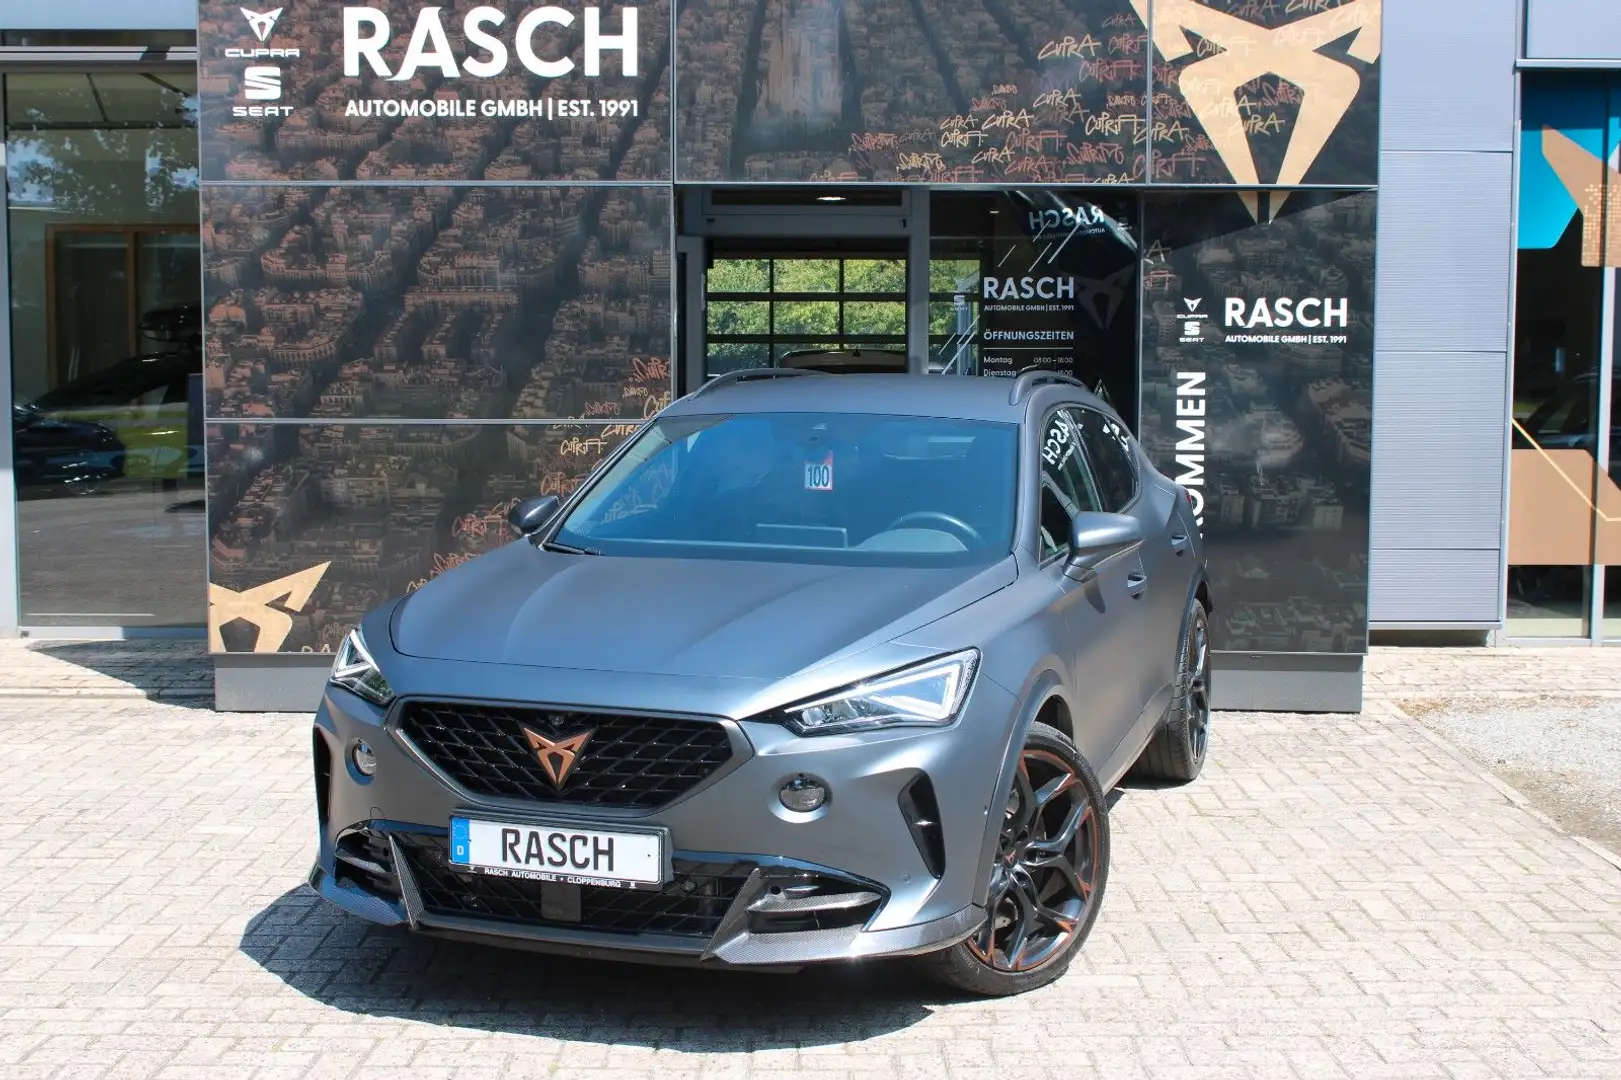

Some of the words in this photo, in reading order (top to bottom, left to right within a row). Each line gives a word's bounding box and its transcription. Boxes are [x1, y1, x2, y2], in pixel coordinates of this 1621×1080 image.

[343, 6, 638, 81] RASCH
[224, 48, 300, 58] CUPRA
[232, 106, 294, 117] SEAT
[345, 99, 477, 117] AUTOMOBILE
[480, 99, 544, 117] GMBH
[558, 100, 595, 117] EST.
[598, 100, 638, 117] 1991
[983, 276, 1075, 300] RASCH
[1224, 297, 1348, 329] RASCH
[983, 329, 1075, 340] ÖFFNUNGSZEITEN
[1225, 334, 1280, 344] AUTOMOBILE
[1281, 335, 1307, 344] GMBH
[1330, 335, 1347, 344] 1991
[983, 356, 1013, 365] Montag
[808, 465, 829, 487] 100
[456, 845, 464, 856] D
[501, 827, 615, 871] RASCH
[484, 867, 508, 877] RASCH
[511, 870, 557, 882] AUTOMOBILE
[567, 877, 621, 888] CLOPPENBURG
